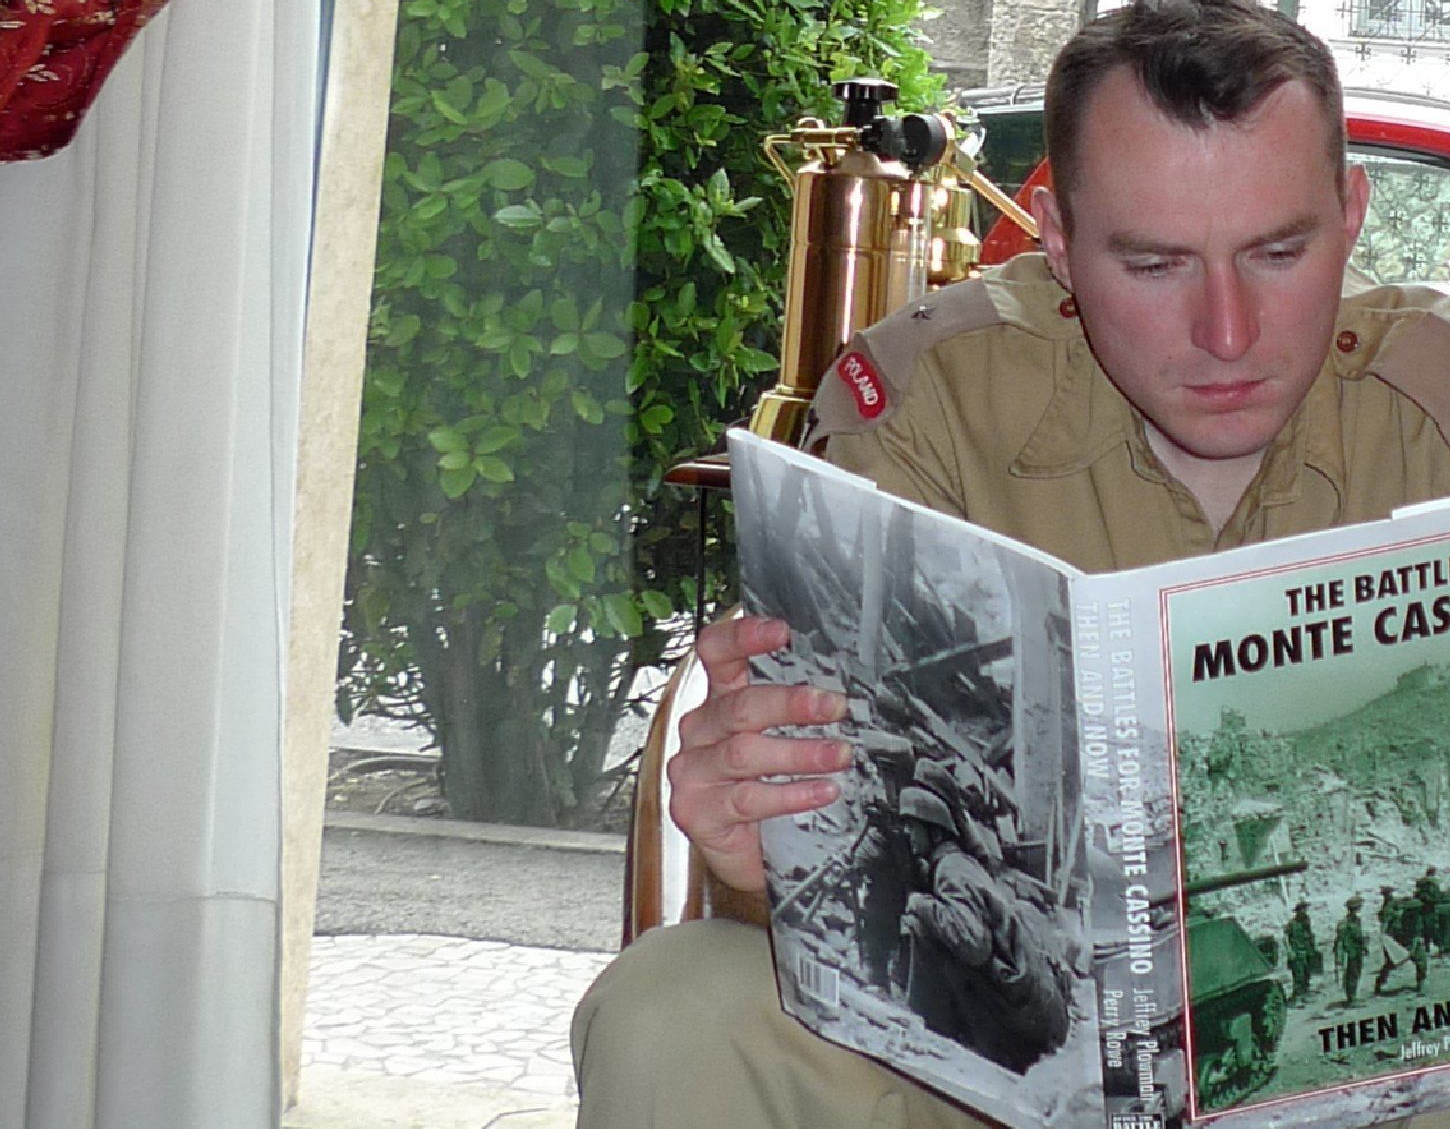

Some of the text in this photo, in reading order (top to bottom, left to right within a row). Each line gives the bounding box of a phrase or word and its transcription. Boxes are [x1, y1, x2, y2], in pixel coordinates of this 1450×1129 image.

[1284, 579, 1345, 616] THE
[1192, 616, 1353, 683] MONTE
[1076, 602, 1109, 778] THEN AND NOW
[1107, 597, 1154, 974] THE BATTLES FOR MONTE CASSINO
[1101, 989, 1127, 1068] Perry Rowe
[1131, 989, 1157, 1036] Jeffrey
[1318, 1014, 1398, 1053] THEN
[1400, 1041, 1441, 1061] Jeffrey
